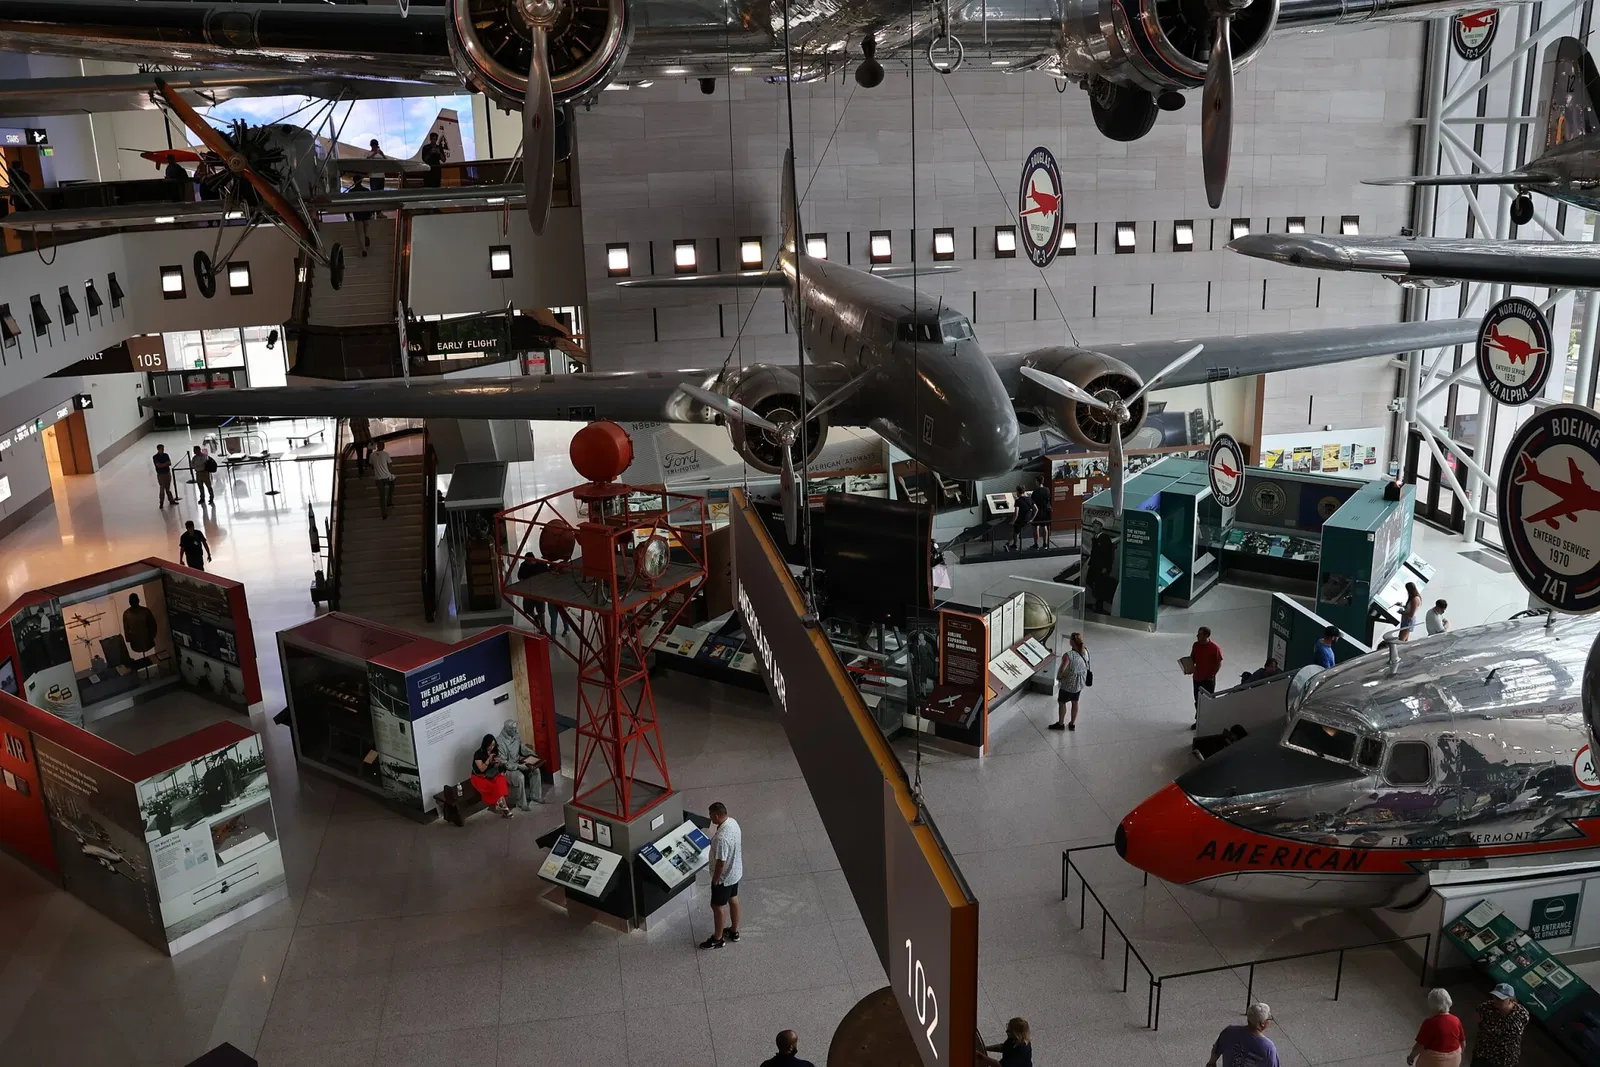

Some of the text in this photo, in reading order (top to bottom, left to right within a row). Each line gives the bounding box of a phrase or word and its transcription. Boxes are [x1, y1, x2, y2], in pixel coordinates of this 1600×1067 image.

[1465, 48, 1479, 58] FC-2
[1566, 74, 1576, 93] 12
[1032, 247, 1046, 264] DC-3
[1498, 302, 1537, 321] NORTHROP
[437, 338, 498, 351] EARLY FLIGHT
[137, 353, 162, 367] 105
[1495, 363, 1526, 376] ENTERED SERVICE
[1489, 379, 1529, 402] 4A ALPHA
[1551, 416, 1600, 449] BOEING
[664, 449, 699, 469] Ford
[808, 453, 876, 472] MERICAN AIRWAYS
[667, 463, 700, 475] TRI-MOTOR
[1533, 527, 1591, 560] ENTERED SERVICE
[1549, 548, 1570, 568] 1970
[1541, 573, 1568, 604] 747
[1271, 620, 1290, 638] ENTRANCE
[420, 688, 431, 699] THE
[432, 681, 449, 696] EARLY
[449, 673, 467, 687] YEARS
[421, 700, 429, 708] OF
[430, 695, 441, 705] AIR
[441, 674, 486, 700] TRANSPORTATION
[4, 732, 26, 763] AIR
[1391, 831, 1531, 846] FLAGSHIP VERMONT
[1196, 839, 1368, 871] AMERICAN
[1532, 920, 1572, 933] NO ENTRANCE
[1541, 929, 1558, 938] OTHER
[1560, 927, 1571, 935] SIDE
[905, 938, 938, 1060] 102
